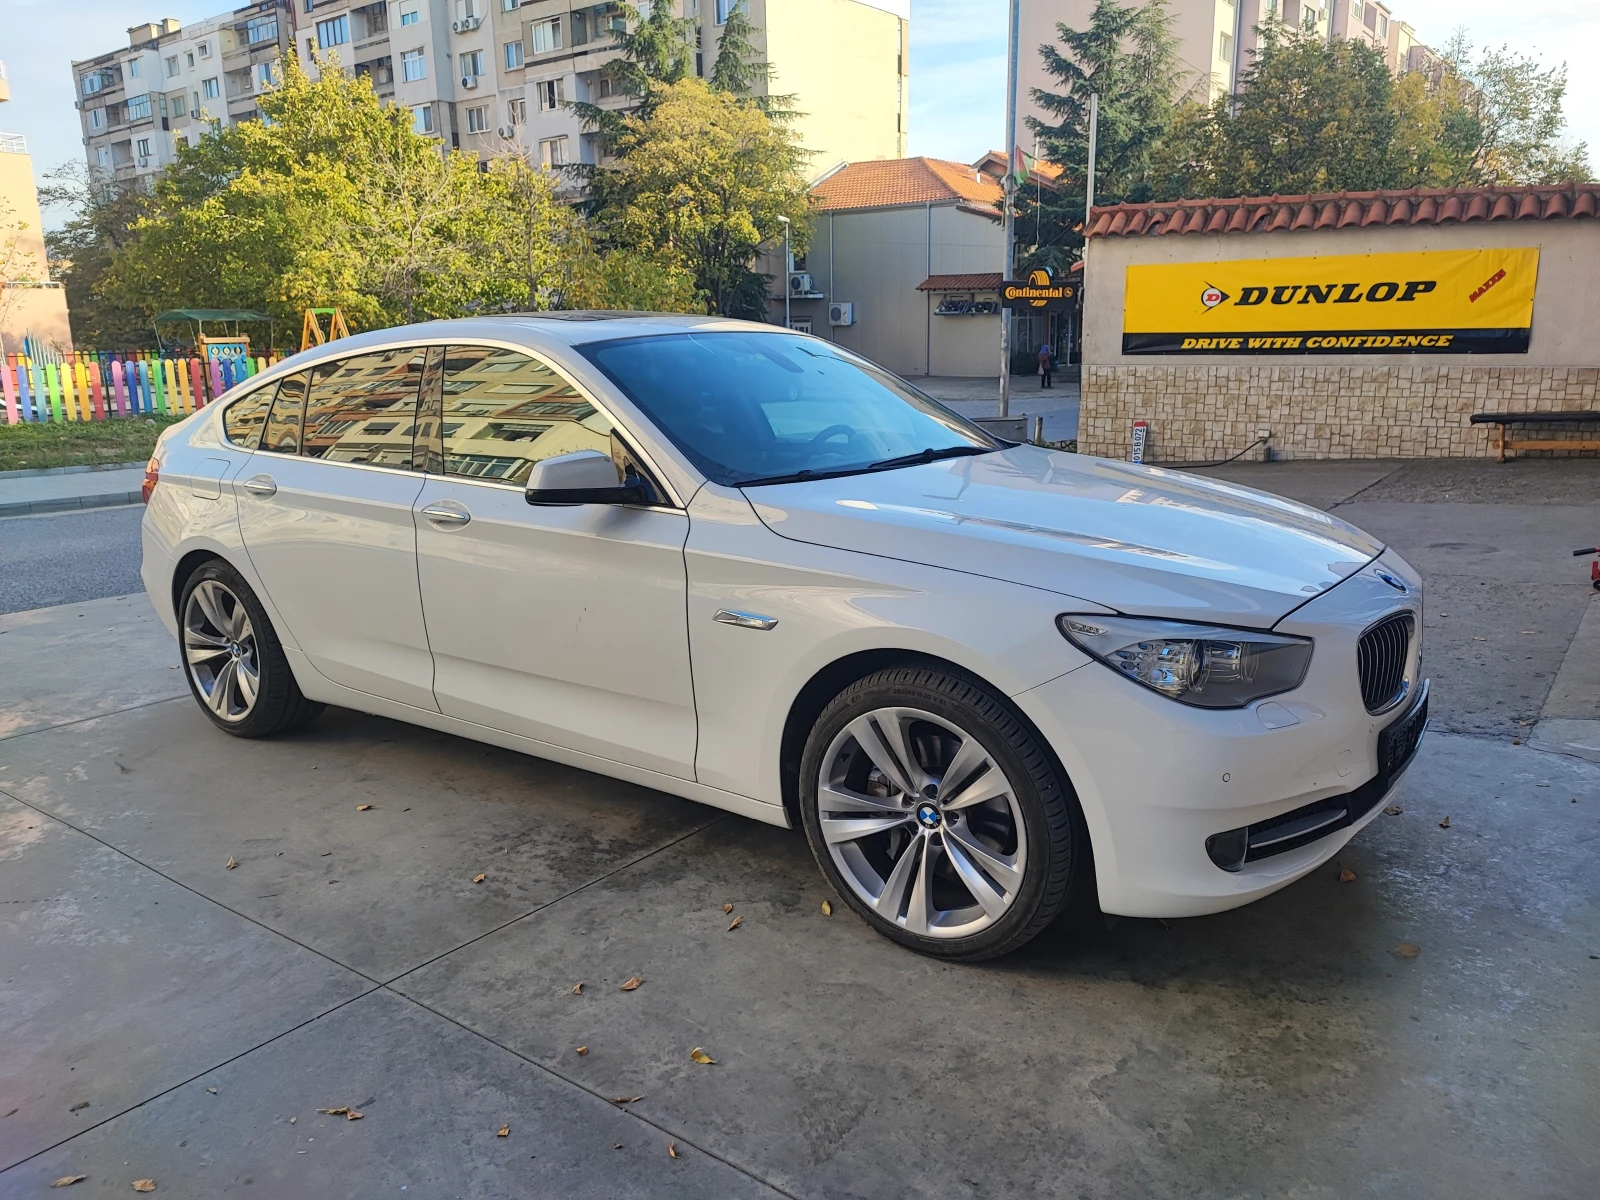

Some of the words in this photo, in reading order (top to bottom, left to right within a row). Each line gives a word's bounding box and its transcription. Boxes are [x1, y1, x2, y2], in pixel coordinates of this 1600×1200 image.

[1005, 286, 1063, 300] Continental
[1205, 293, 1220, 302] D
[1233, 281, 1437, 306] DUNLOP
[1468, 268, 1507, 303] MAXXIS
[1180, 337, 1243, 349] DRIVE
[1248, 337, 1303, 349] WITH
[1305, 334, 1455, 349] CONFIDENCE
